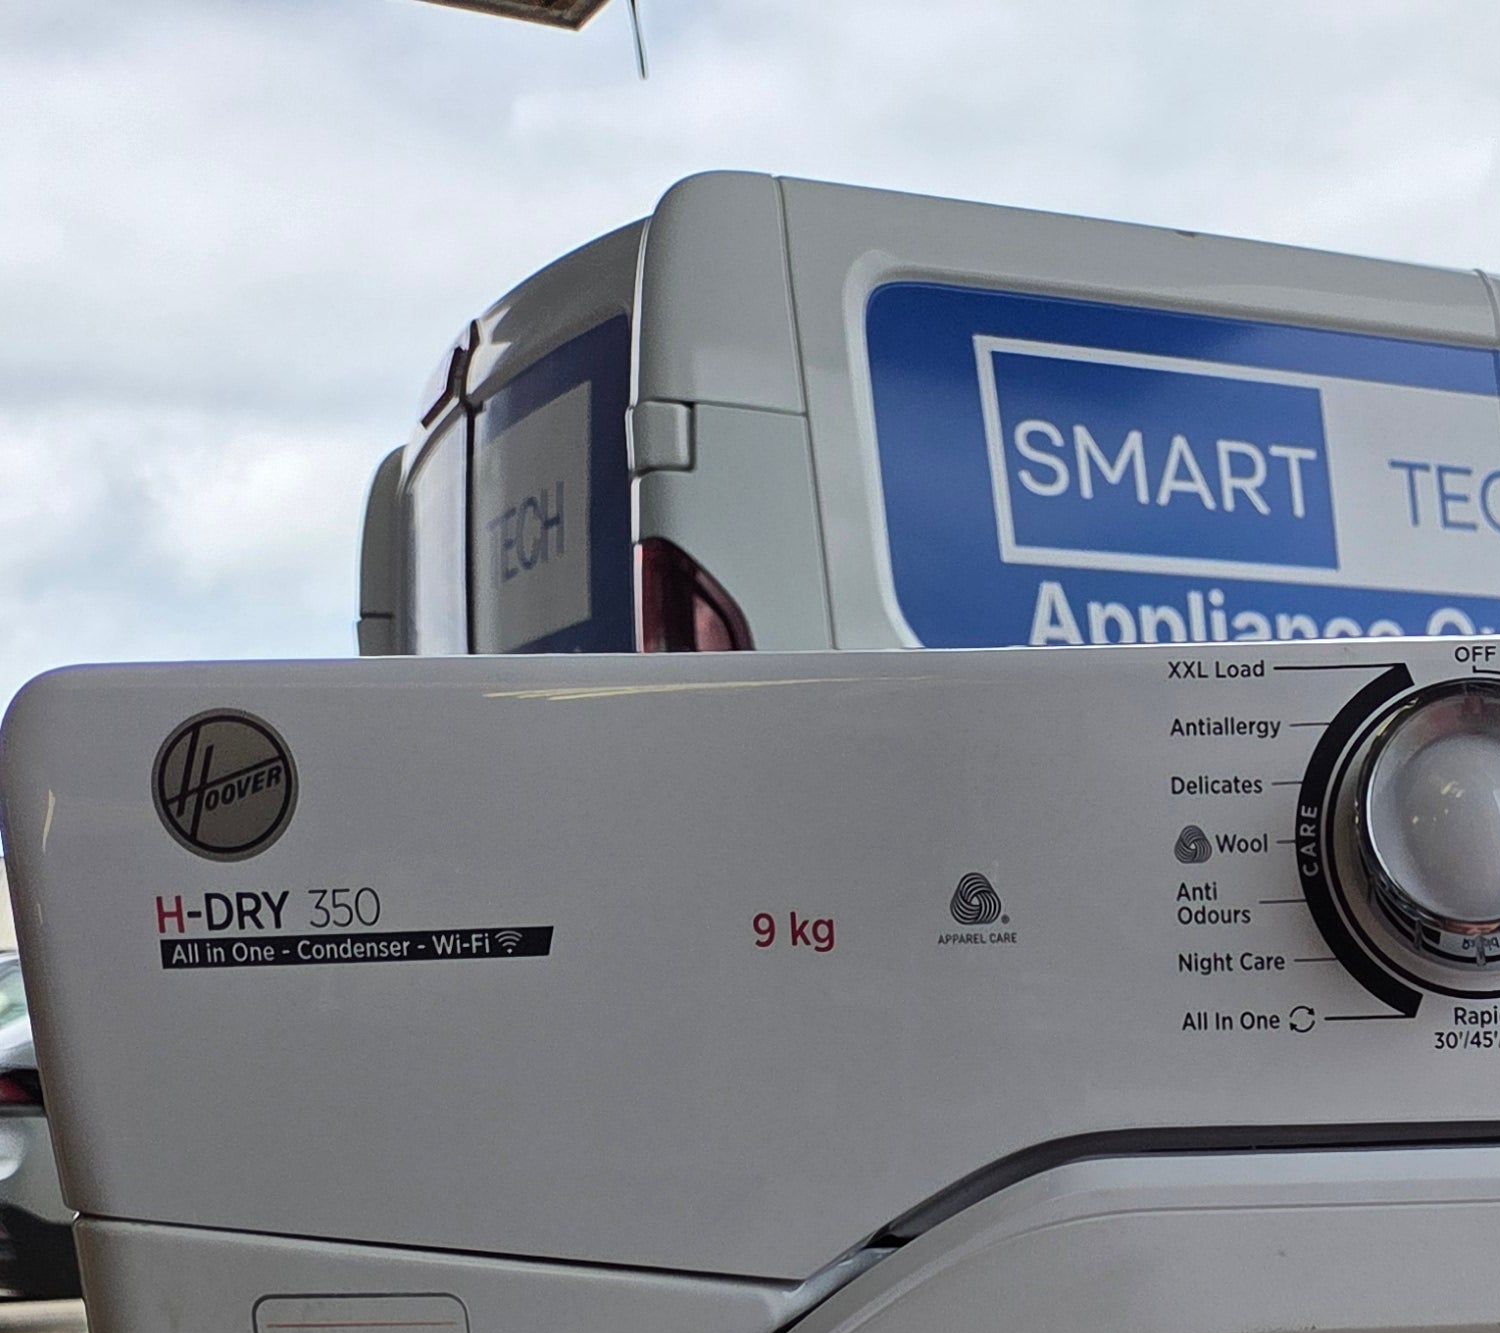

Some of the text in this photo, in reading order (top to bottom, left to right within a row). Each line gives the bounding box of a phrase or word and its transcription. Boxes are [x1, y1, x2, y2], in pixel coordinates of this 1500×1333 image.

[1014, 418, 1318, 520] SMART
[1455, 646, 1496, 662] OFF
[1168, 660, 1265, 678] XXL Load
[1170, 718, 1281, 738] Antiallergy
[1171, 776, 1263, 794] Delicates
[1216, 833, 1268, 853] Wool
[1299, 803, 1318, 877] CARE
[1176, 882, 1218, 900] Anti
[156, 887, 381, 934] H-DRY 350
[1177, 906, 1251, 924] Odours
[752, 911, 836, 952] 9 kg
[937, 932, 1018, 945] APPAREL CARE
[171, 945, 200, 965] All
[207, 944, 225, 963] in
[231, 942, 276, 962] One
[298, 935, 411, 961] Condenser
[432, 933, 490, 955] Wi-Fi
[1178, 952, 1286, 976] Night Care
[1182, 1010, 1281, 1030] All In One
